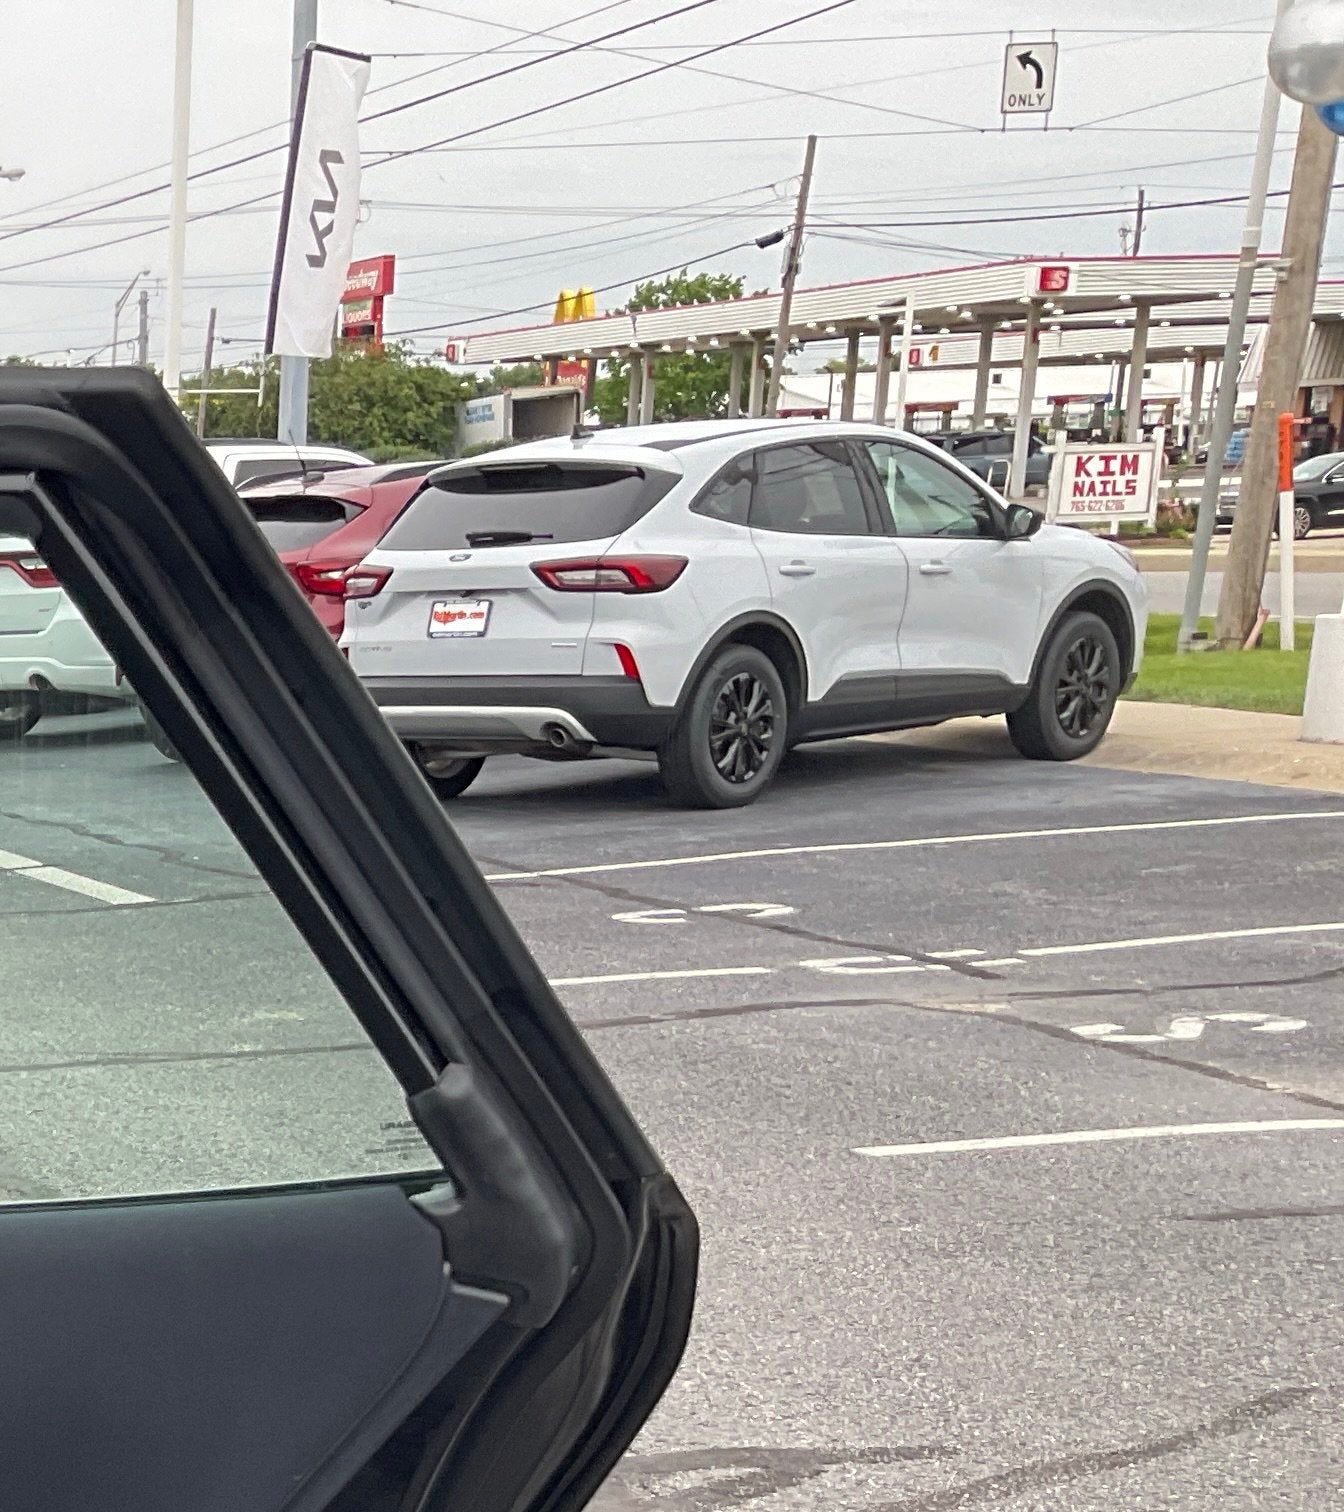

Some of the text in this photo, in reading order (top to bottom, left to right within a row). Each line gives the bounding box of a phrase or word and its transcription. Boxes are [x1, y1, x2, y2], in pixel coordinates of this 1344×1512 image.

[1008, 93, 1046, 107] ONLY
[1074, 454, 1139, 478] KIM
[1072, 479, 1137, 497] NAILS
